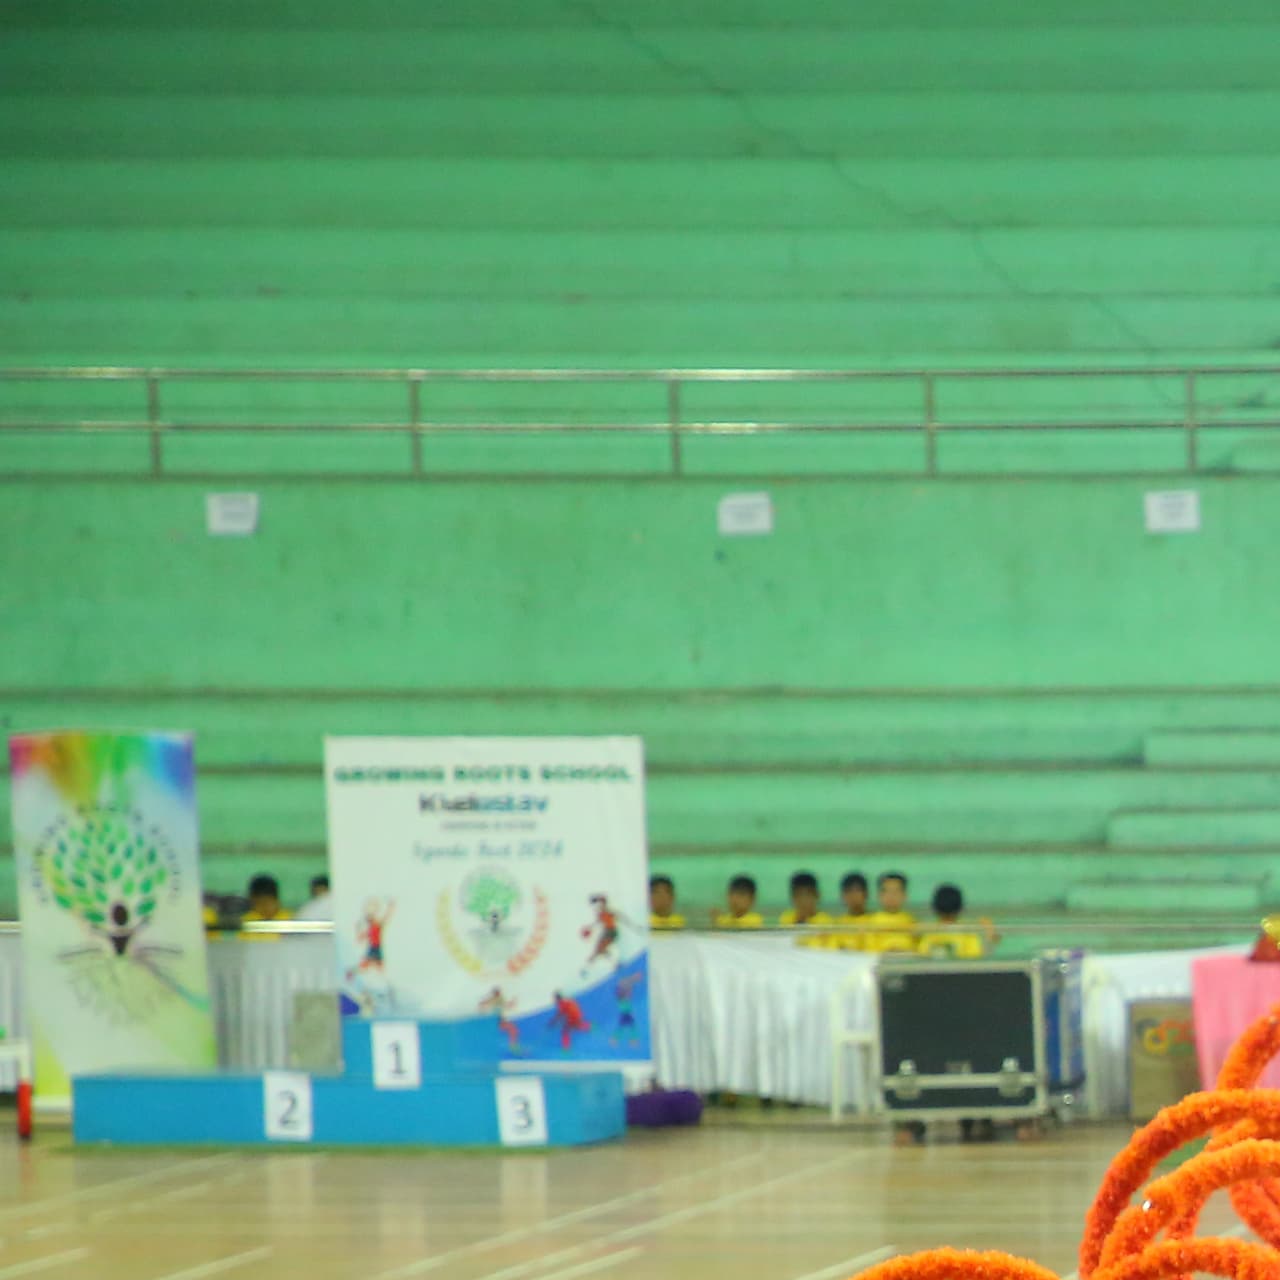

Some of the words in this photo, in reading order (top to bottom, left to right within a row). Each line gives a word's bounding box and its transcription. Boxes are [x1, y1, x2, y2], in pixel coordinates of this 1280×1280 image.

[334, 766, 444, 782] GROWING
[454, 766, 530, 782] ROOTS
[540, 766, 630, 782] SCHOOL
[388, 1039, 406, 1075] 1
[277, 1089, 297, 1128] 2
[512, 1094, 533, 1131] 3
